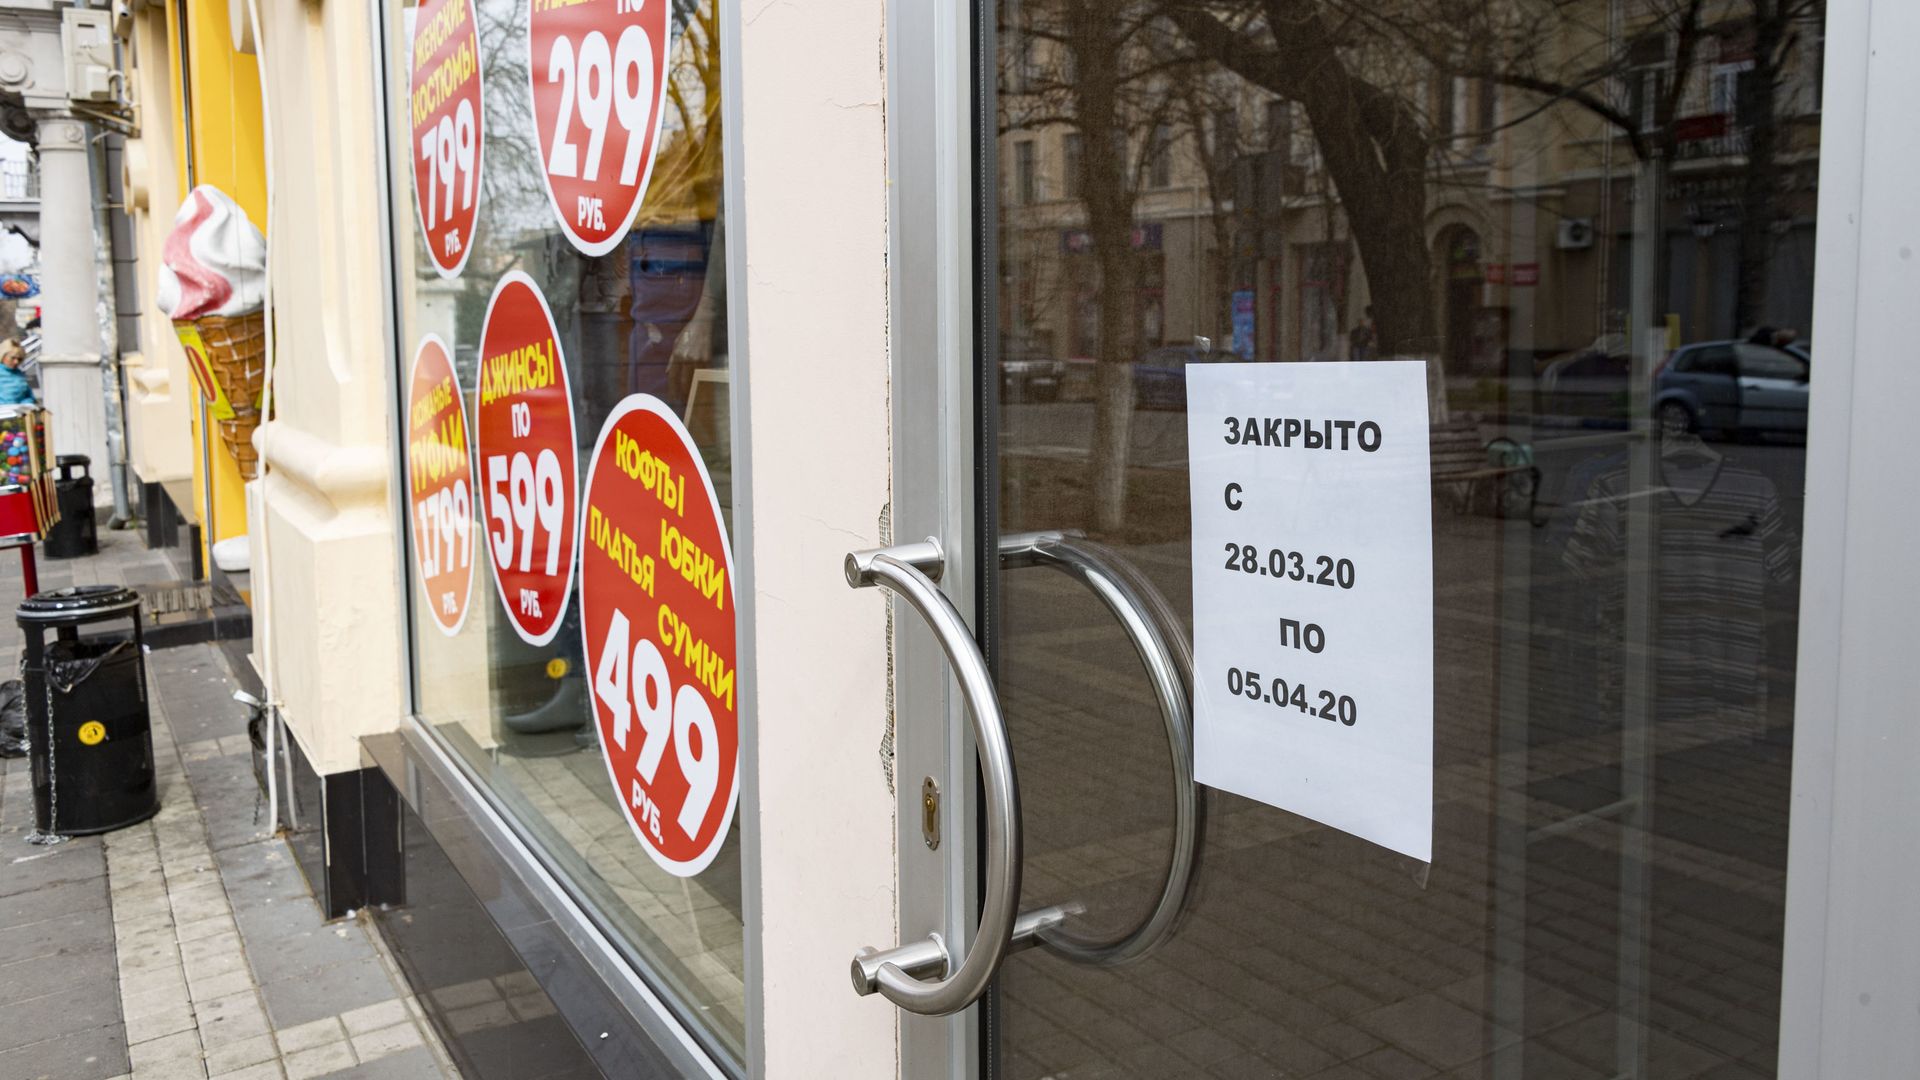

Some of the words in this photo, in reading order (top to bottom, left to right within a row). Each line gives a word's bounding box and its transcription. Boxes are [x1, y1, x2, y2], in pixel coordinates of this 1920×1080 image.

[415, 0, 466, 73] ЖЕНСКИЕ
[412, 31, 477, 129] КОСТЮМЫ
[548, 25, 655, 187] 299
[421, 98, 476, 231] 799
[577, 195, 607, 232] РУБ.
[481, 338, 556, 406] ДЖИНСЫ
[410, 408, 467, 494] ТУФЛИ
[511, 402, 531, 438] ПО
[1223, 416, 1383, 453] ЗАКРЫТО
[615, 428, 685, 517] КОФТЫ
[1223, 482, 1243, 512] С
[417, 478, 470, 580] 1799
[488, 448, 565, 577] 599
[590, 505, 655, 598] ПЛАТЬЯ
[520, 588, 543, 619] РУБ.
[660, 518, 725, 610] ЮБКИ
[1224, 542, 1356, 590] 28.03.20
[657, 603, 735, 712] СУМКИ
[1279, 617, 1326, 654] ПО
[596, 607, 720, 842] 499
[1226, 667, 1358, 727] 05.04.20
[632, 779, 664, 845] РУБ.
